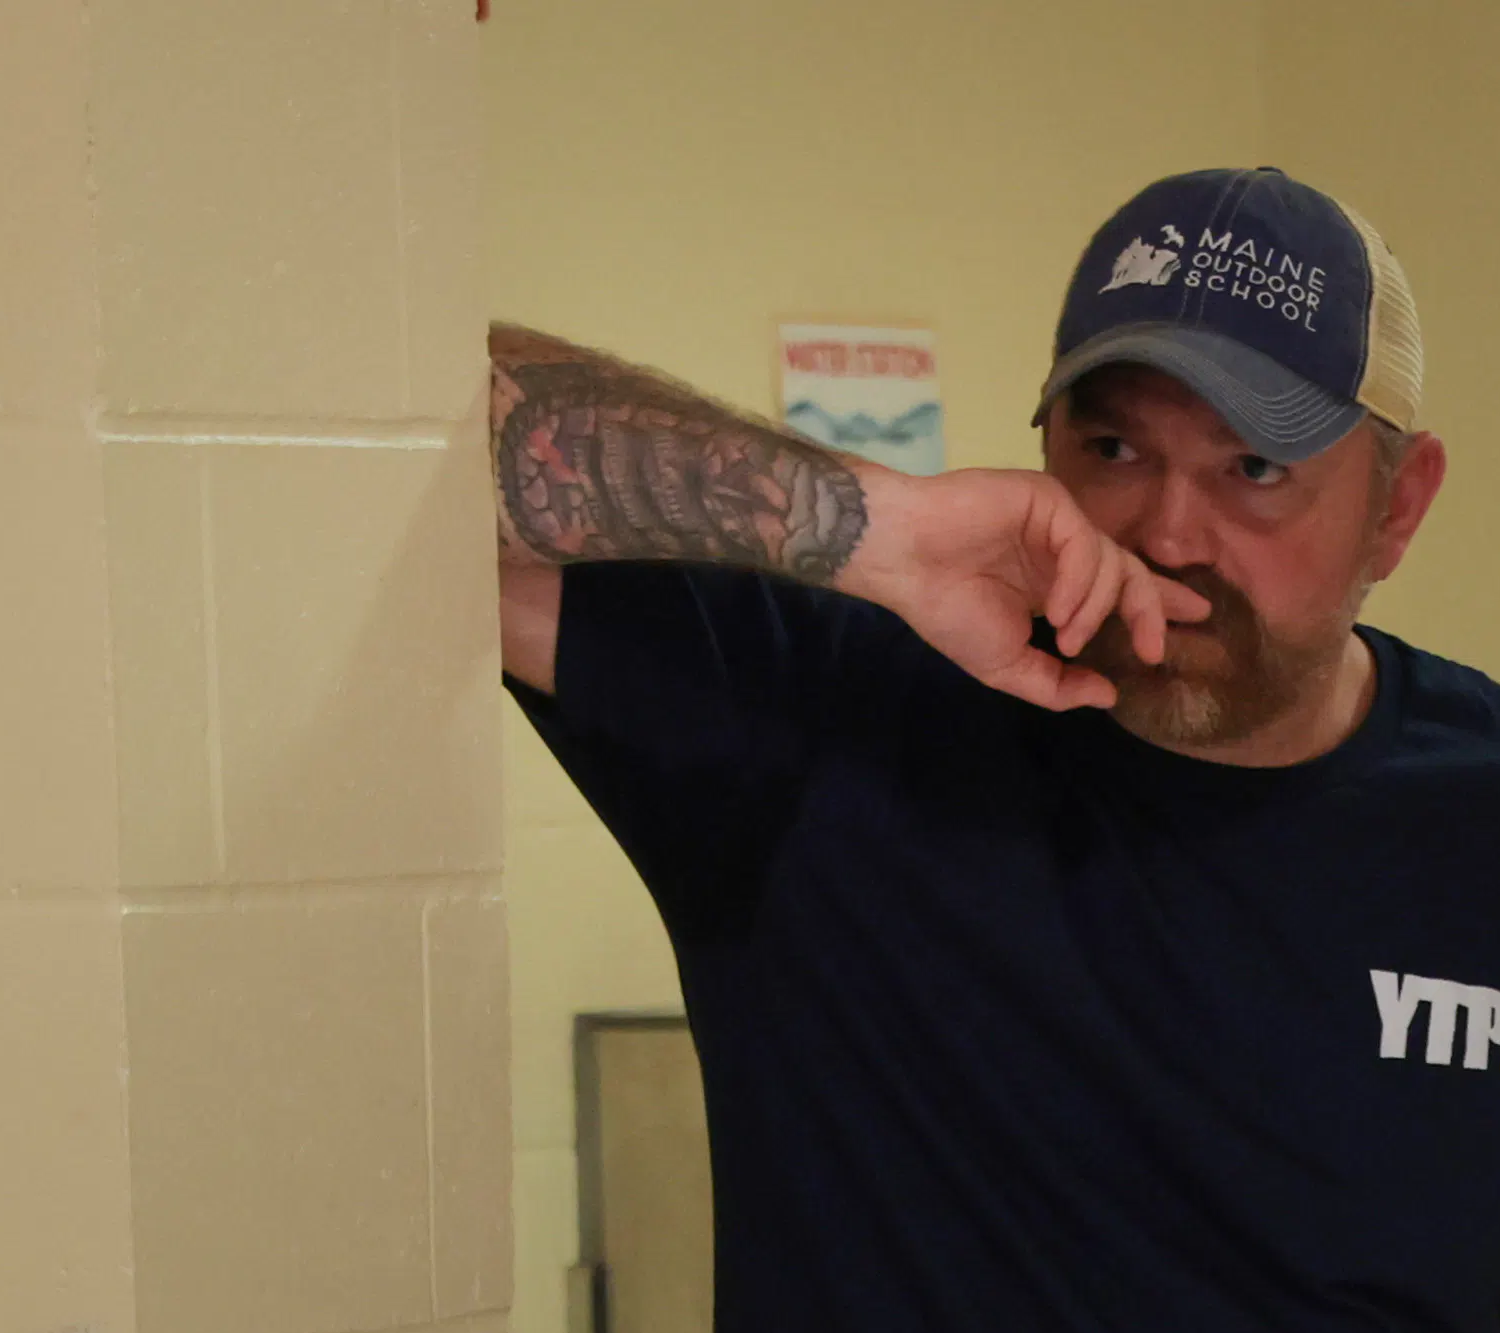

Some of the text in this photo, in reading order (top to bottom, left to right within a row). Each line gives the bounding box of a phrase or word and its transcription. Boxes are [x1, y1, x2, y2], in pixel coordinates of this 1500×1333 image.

[1192, 252, 1321, 312] OUTDOOR
[1198, 227, 1327, 293] MAINE
[1184, 270, 1317, 333] SCHOOL
